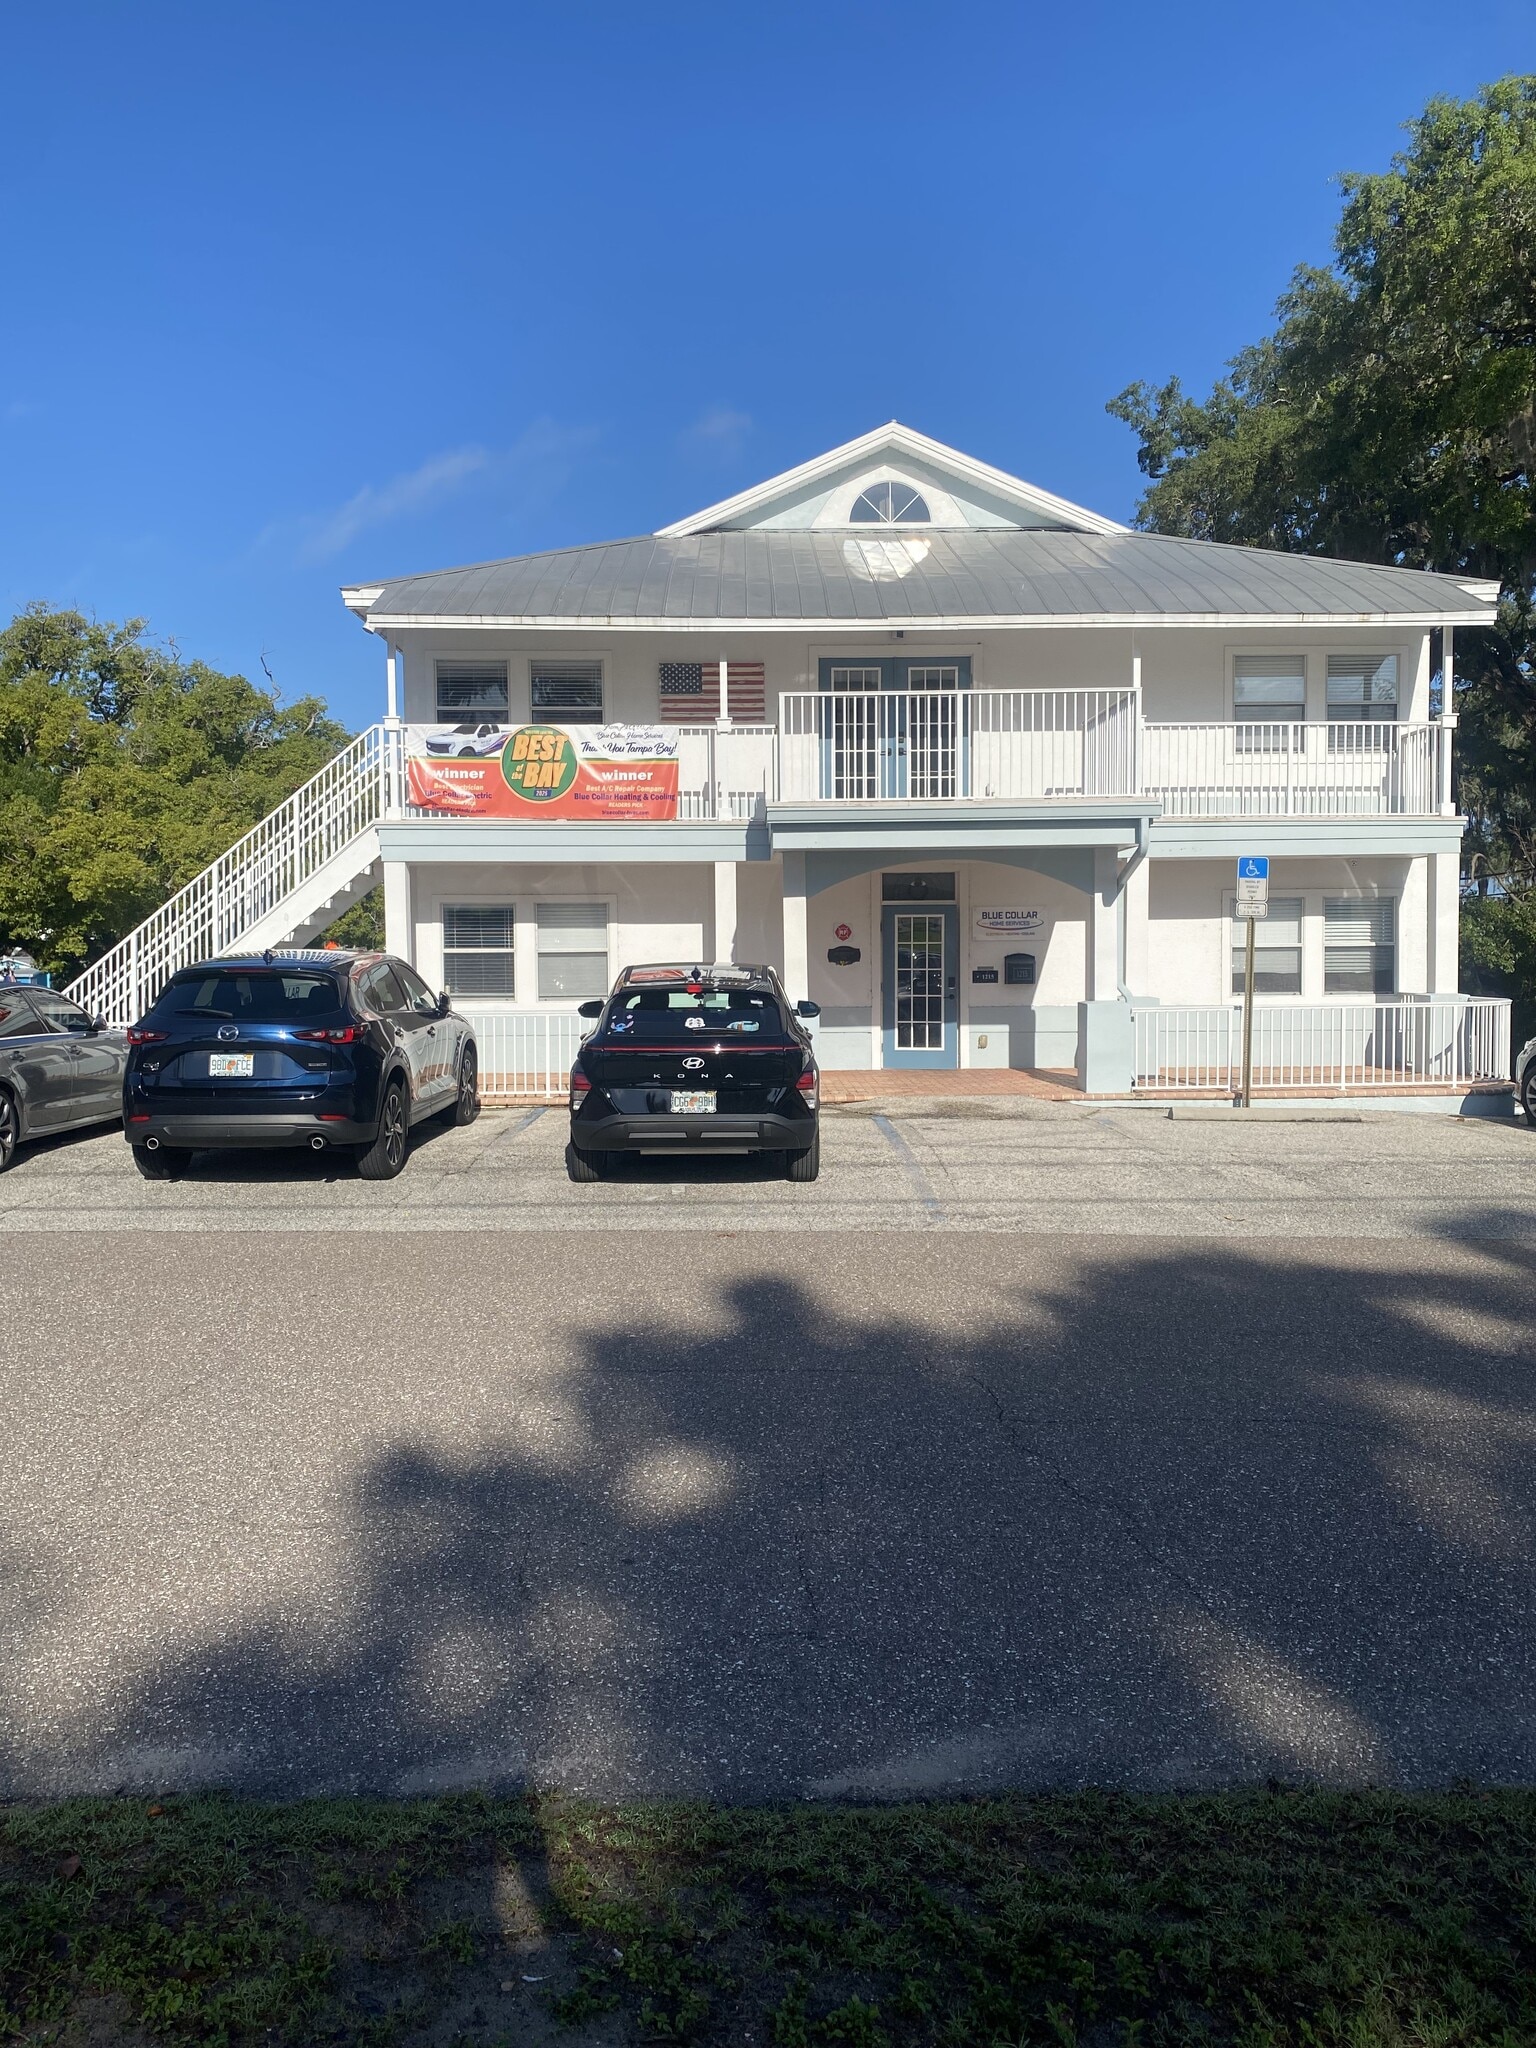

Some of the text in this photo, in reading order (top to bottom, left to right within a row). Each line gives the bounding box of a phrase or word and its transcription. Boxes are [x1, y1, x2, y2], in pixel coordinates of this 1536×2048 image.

[626, 732, 644, 740] Home
[511, 735, 569, 761] BEST
[581, 741, 678, 755] Tha You Tampa Bay!
[432, 768, 485, 779] winner
[522, 762, 567, 788] BAY
[602, 770, 653, 780] winner
[450, 783, 484, 791] Ectrician
[615, 785, 635, 793] Repair
[636, 785, 665, 793] Company
[614, 793, 641, 801] Heating
[650, 793, 675, 801] Cooling
[982, 911, 1038, 919] BLUE COLLAR
[237, 1060, 251, 1070] FCE
